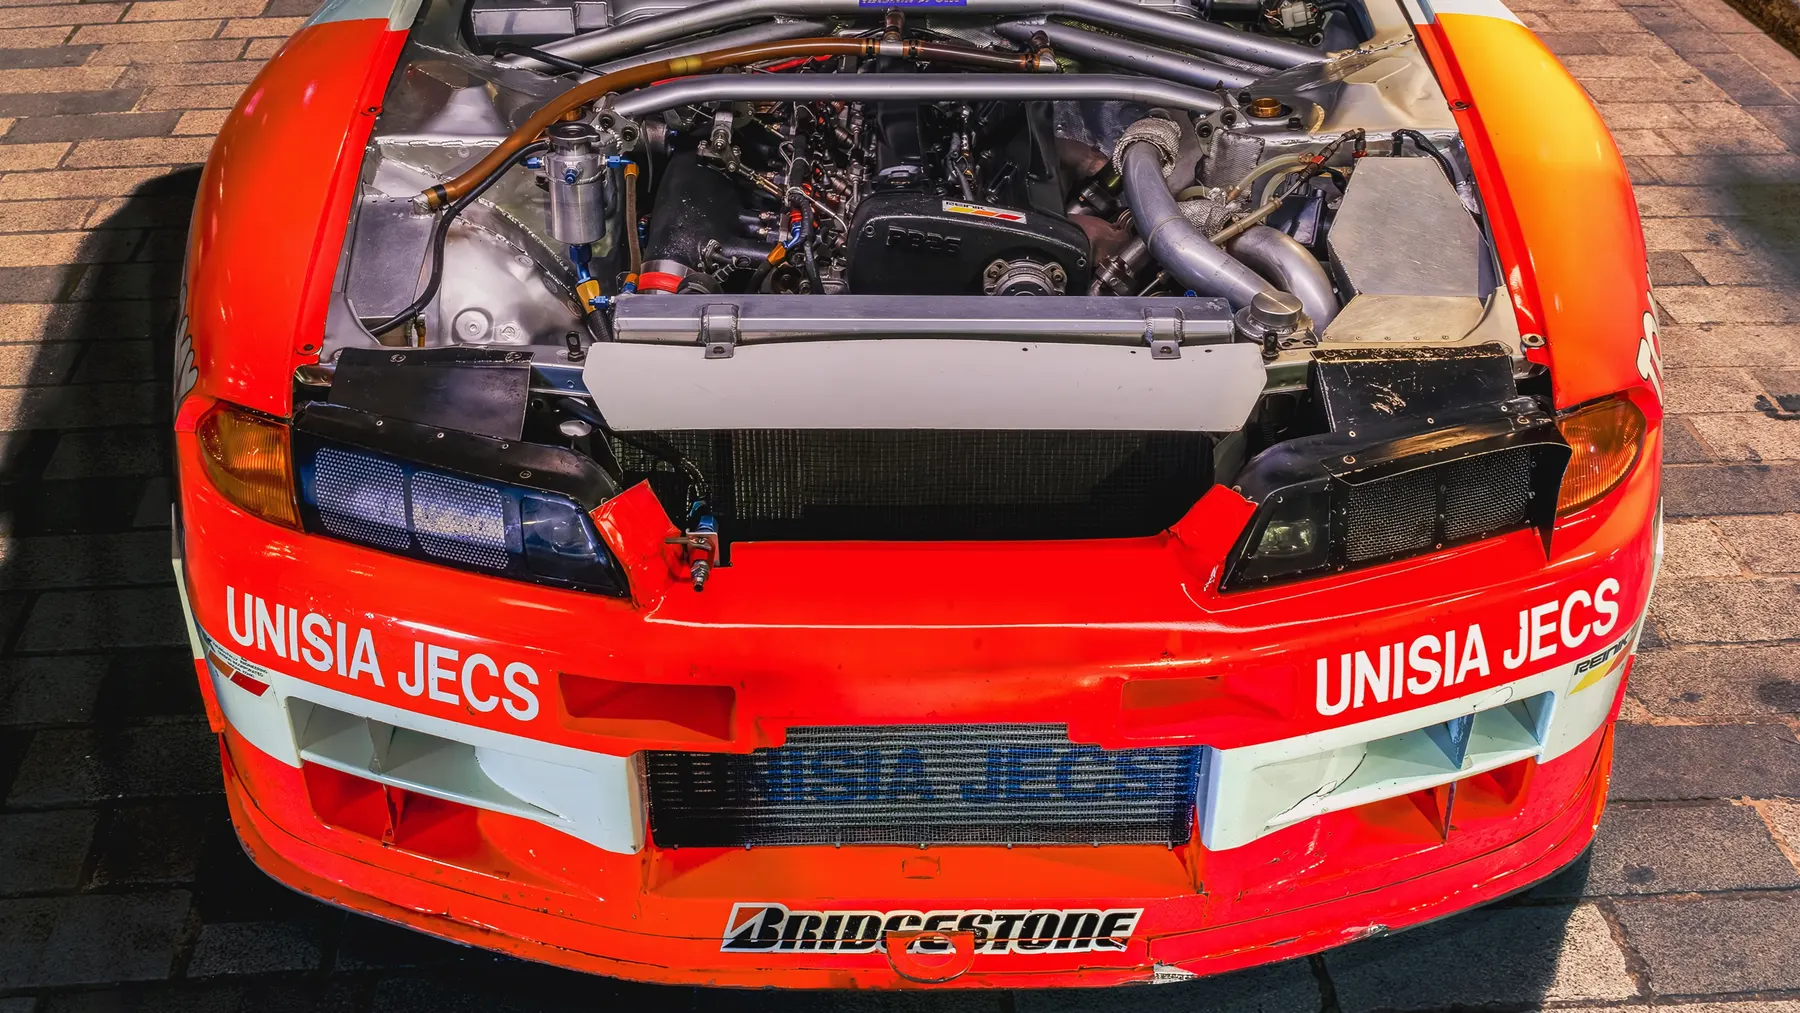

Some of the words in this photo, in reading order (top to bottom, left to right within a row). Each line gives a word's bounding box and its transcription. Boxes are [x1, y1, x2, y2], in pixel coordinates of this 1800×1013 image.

[226, 585, 385, 688] UNISIA
[397, 640, 540, 722] JECS
[1316, 623, 1491, 716] UNISIA
[1503, 577, 1620, 670] JECS
[958, 747, 1151, 802] JECS
